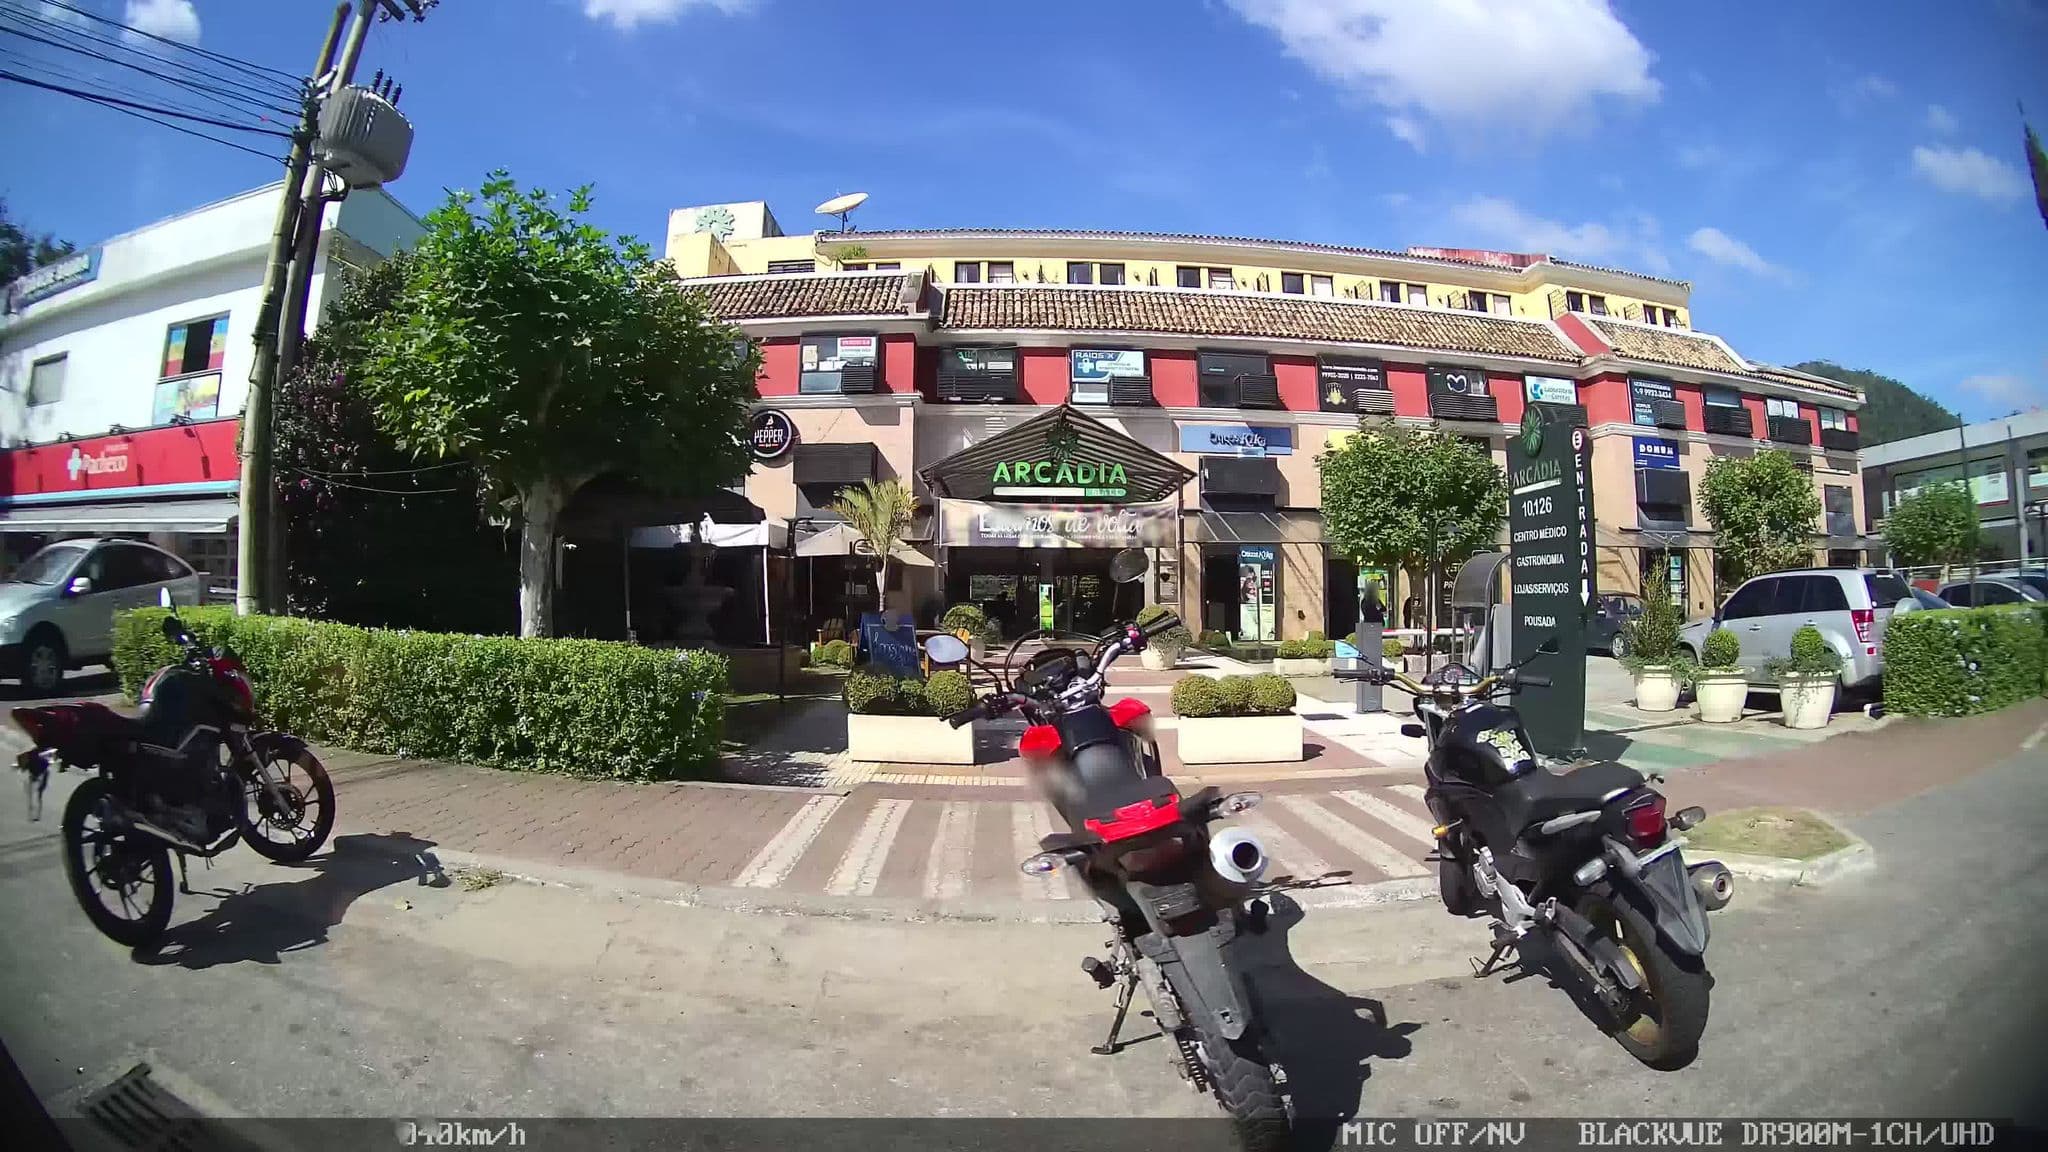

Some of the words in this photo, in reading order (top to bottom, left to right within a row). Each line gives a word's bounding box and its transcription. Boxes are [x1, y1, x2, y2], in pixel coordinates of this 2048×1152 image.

[1075, 351, 1105, 359] RAIOS
[1107, 352, 1115, 360] X
[1521, 496, 1553, 518] 10.126
[1575, 453, 1589, 575] ENTRADA
[1513, 529, 1539, 543] CENTRO
[1539, 525, 1568, 539] MÉDICO
[1516, 554, 1565, 567] GASTRONOMIA
[1514, 583, 1569, 596] LOJAS/SERVIÇOS
[1524, 615, 1556, 628] POUSADA
